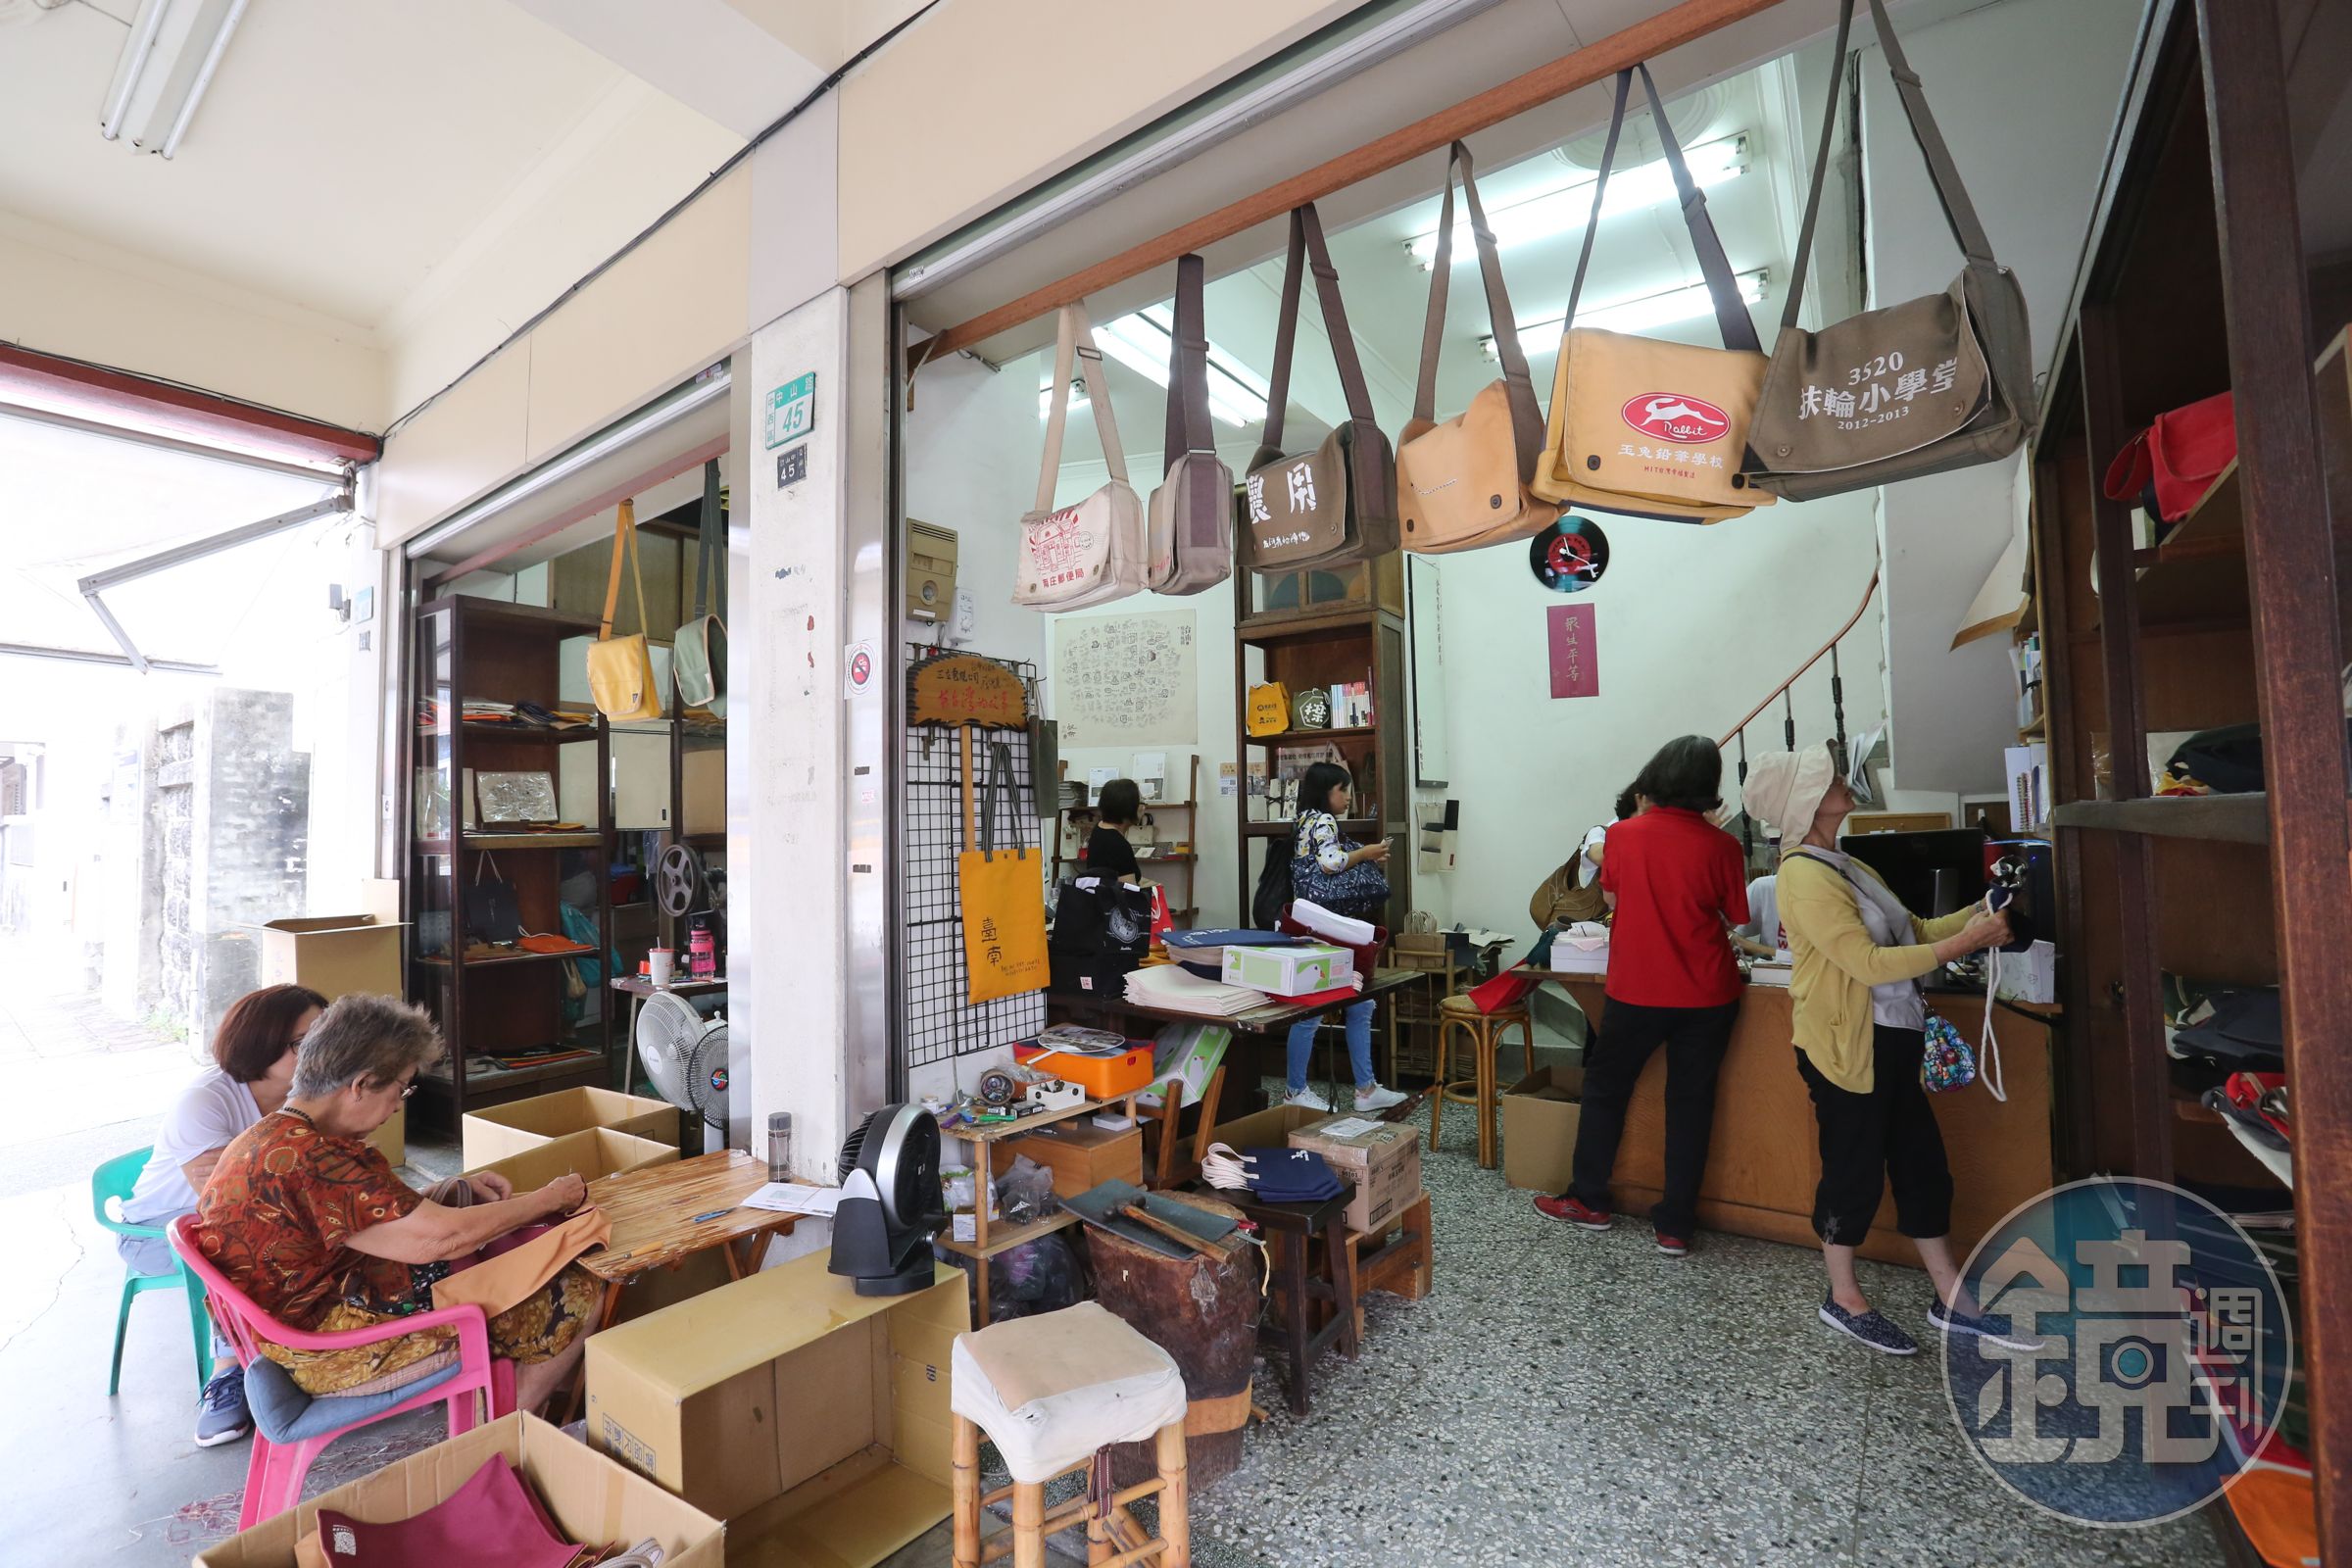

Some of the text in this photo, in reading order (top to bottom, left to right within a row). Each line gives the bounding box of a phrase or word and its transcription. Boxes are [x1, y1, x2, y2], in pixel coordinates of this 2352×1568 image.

[1848, 351, 1903, 385] 3520
[775, 375, 813, 405] 中山路
[1797, 357, 1958, 420] 扶輪小學堂
[782, 401, 805, 432] 45
[1663, 420, 1707, 439] Rabbit
[1838, 406, 1910, 430] 2012-2013
[780, 464, 796, 481] 45
[981, 916, 1003, 967] 臺南
